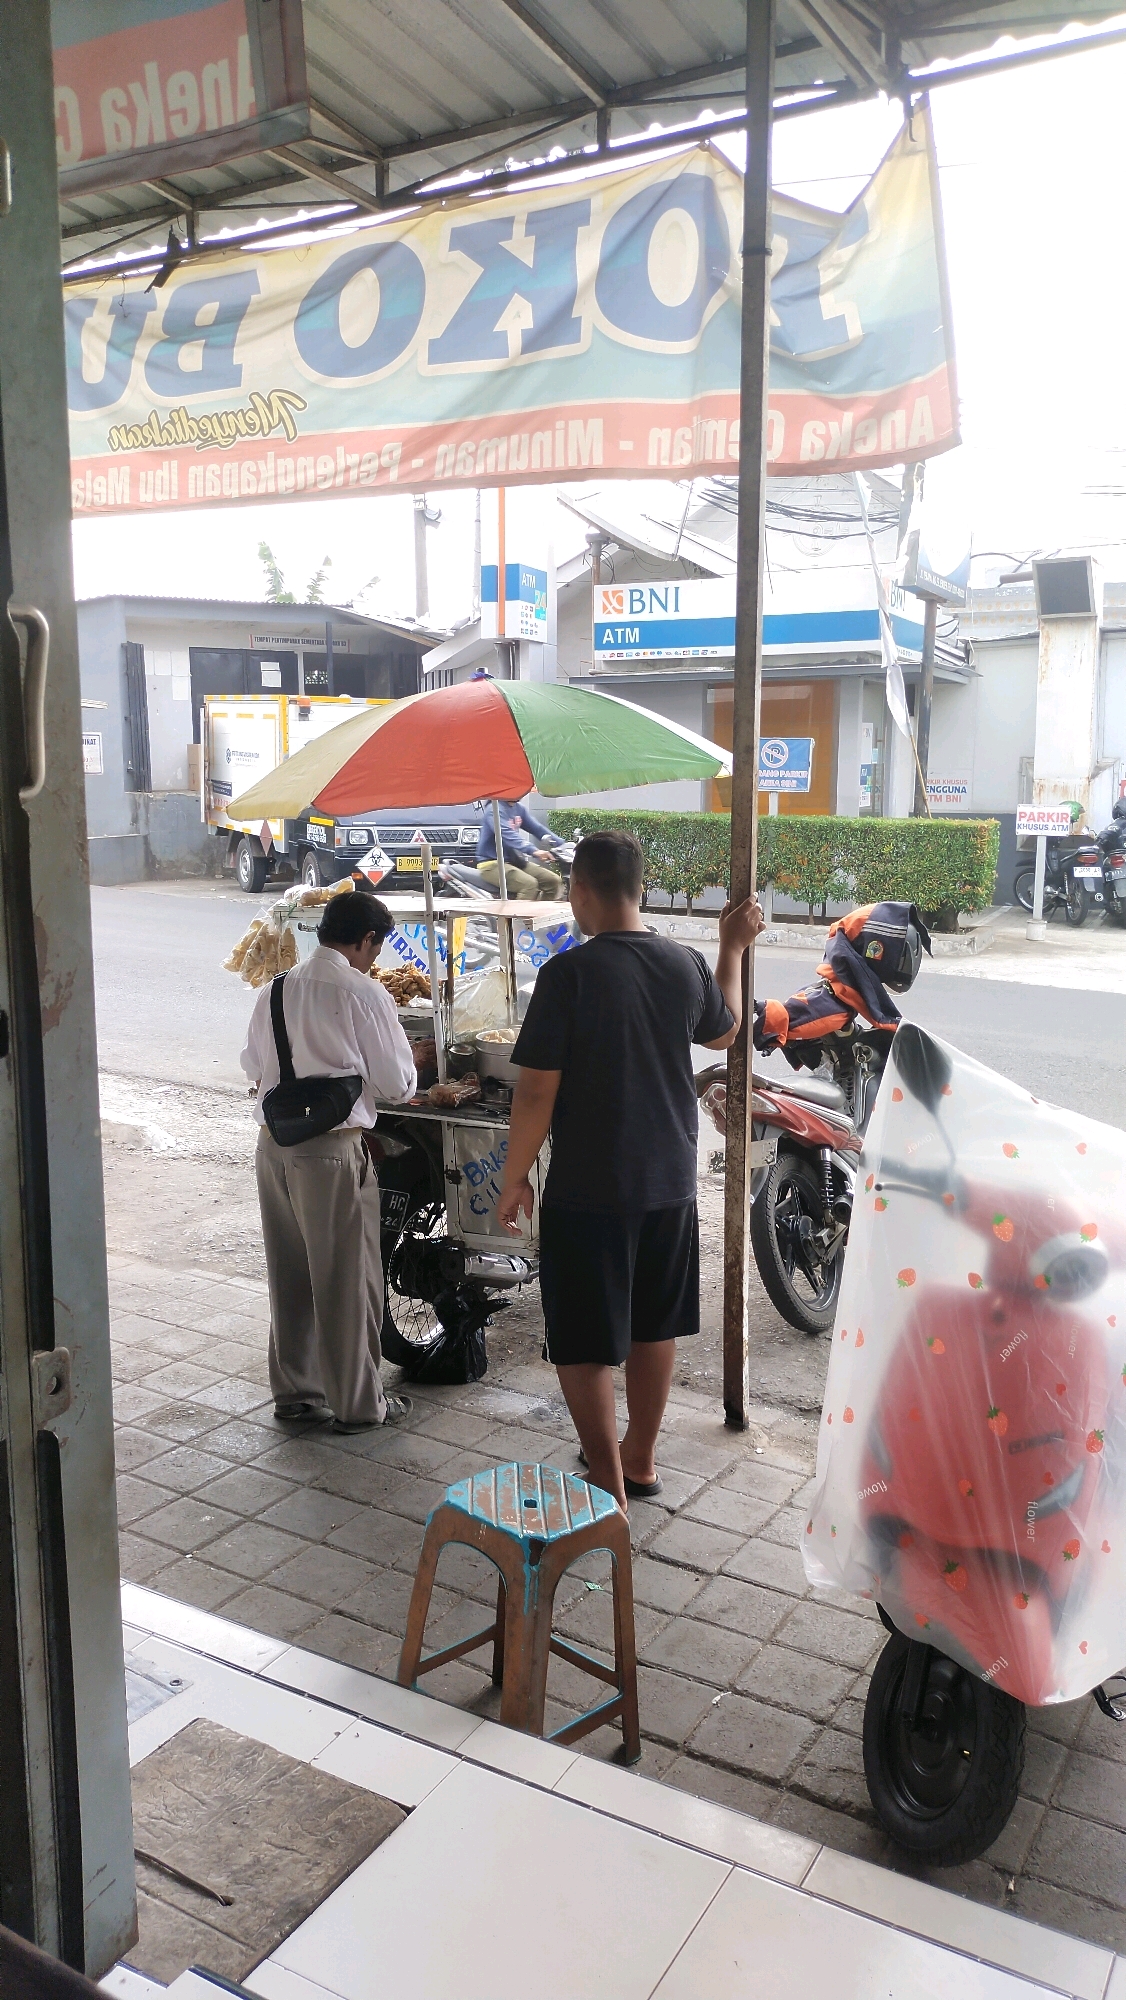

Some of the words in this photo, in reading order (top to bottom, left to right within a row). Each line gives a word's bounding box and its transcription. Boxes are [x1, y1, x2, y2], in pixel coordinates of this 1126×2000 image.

[522, 572, 536, 589] ATM
[628, 586, 681, 615] BNI
[602, 627, 640, 645] ATM
[926, 786, 967, 794] ENGGUNA
[927, 794, 943, 803] TM
[945, 794, 962, 803] BNI
[1018, 811, 1070, 823] PARKIR
[1017, 823, 1049, 831] KHUSUS
[1051, 824, 1069, 832] ATM
[999, 1329, 1029, 1362] flower
[1026, 1500, 1039, 1543] flower
